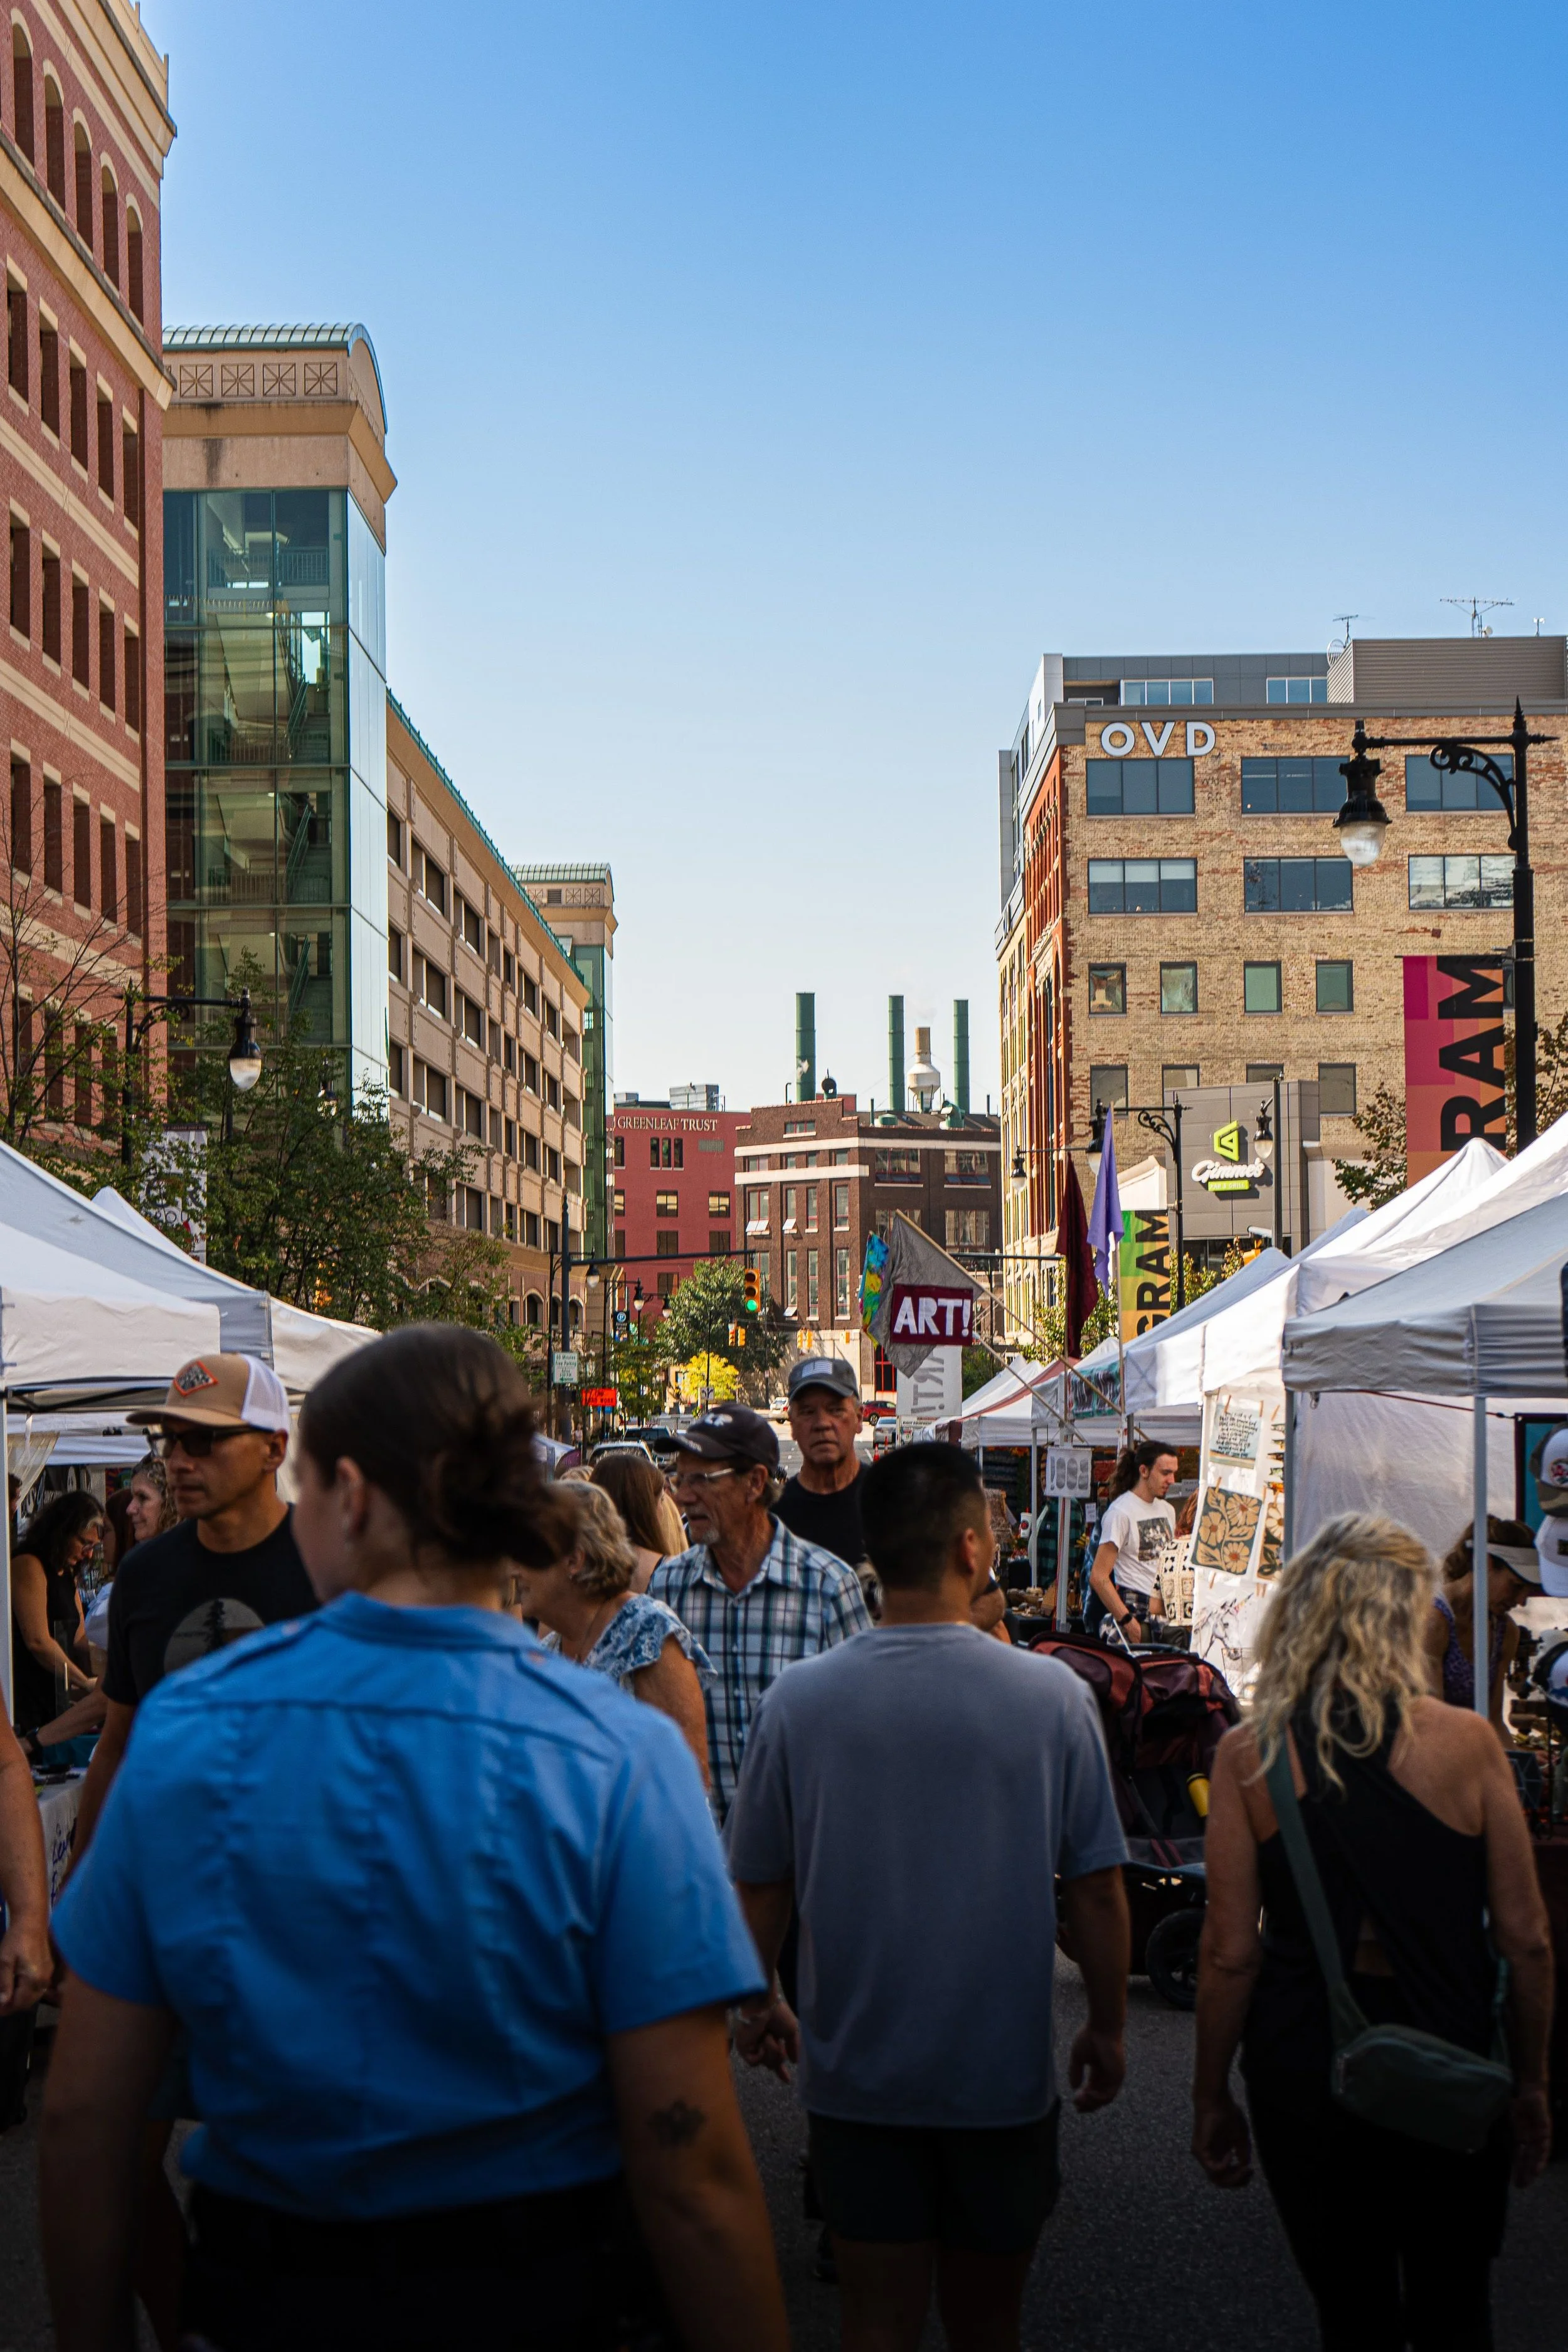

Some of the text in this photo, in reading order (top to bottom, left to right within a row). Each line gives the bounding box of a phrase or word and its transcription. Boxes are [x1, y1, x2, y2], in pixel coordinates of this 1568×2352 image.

[1101, 721, 1216, 756] OVD
[617, 1116, 718, 1131] GREENLEAF TRUST
[1192, 1157, 1265, 1184] Gimme's
[893, 1296, 971, 1337] ART!
